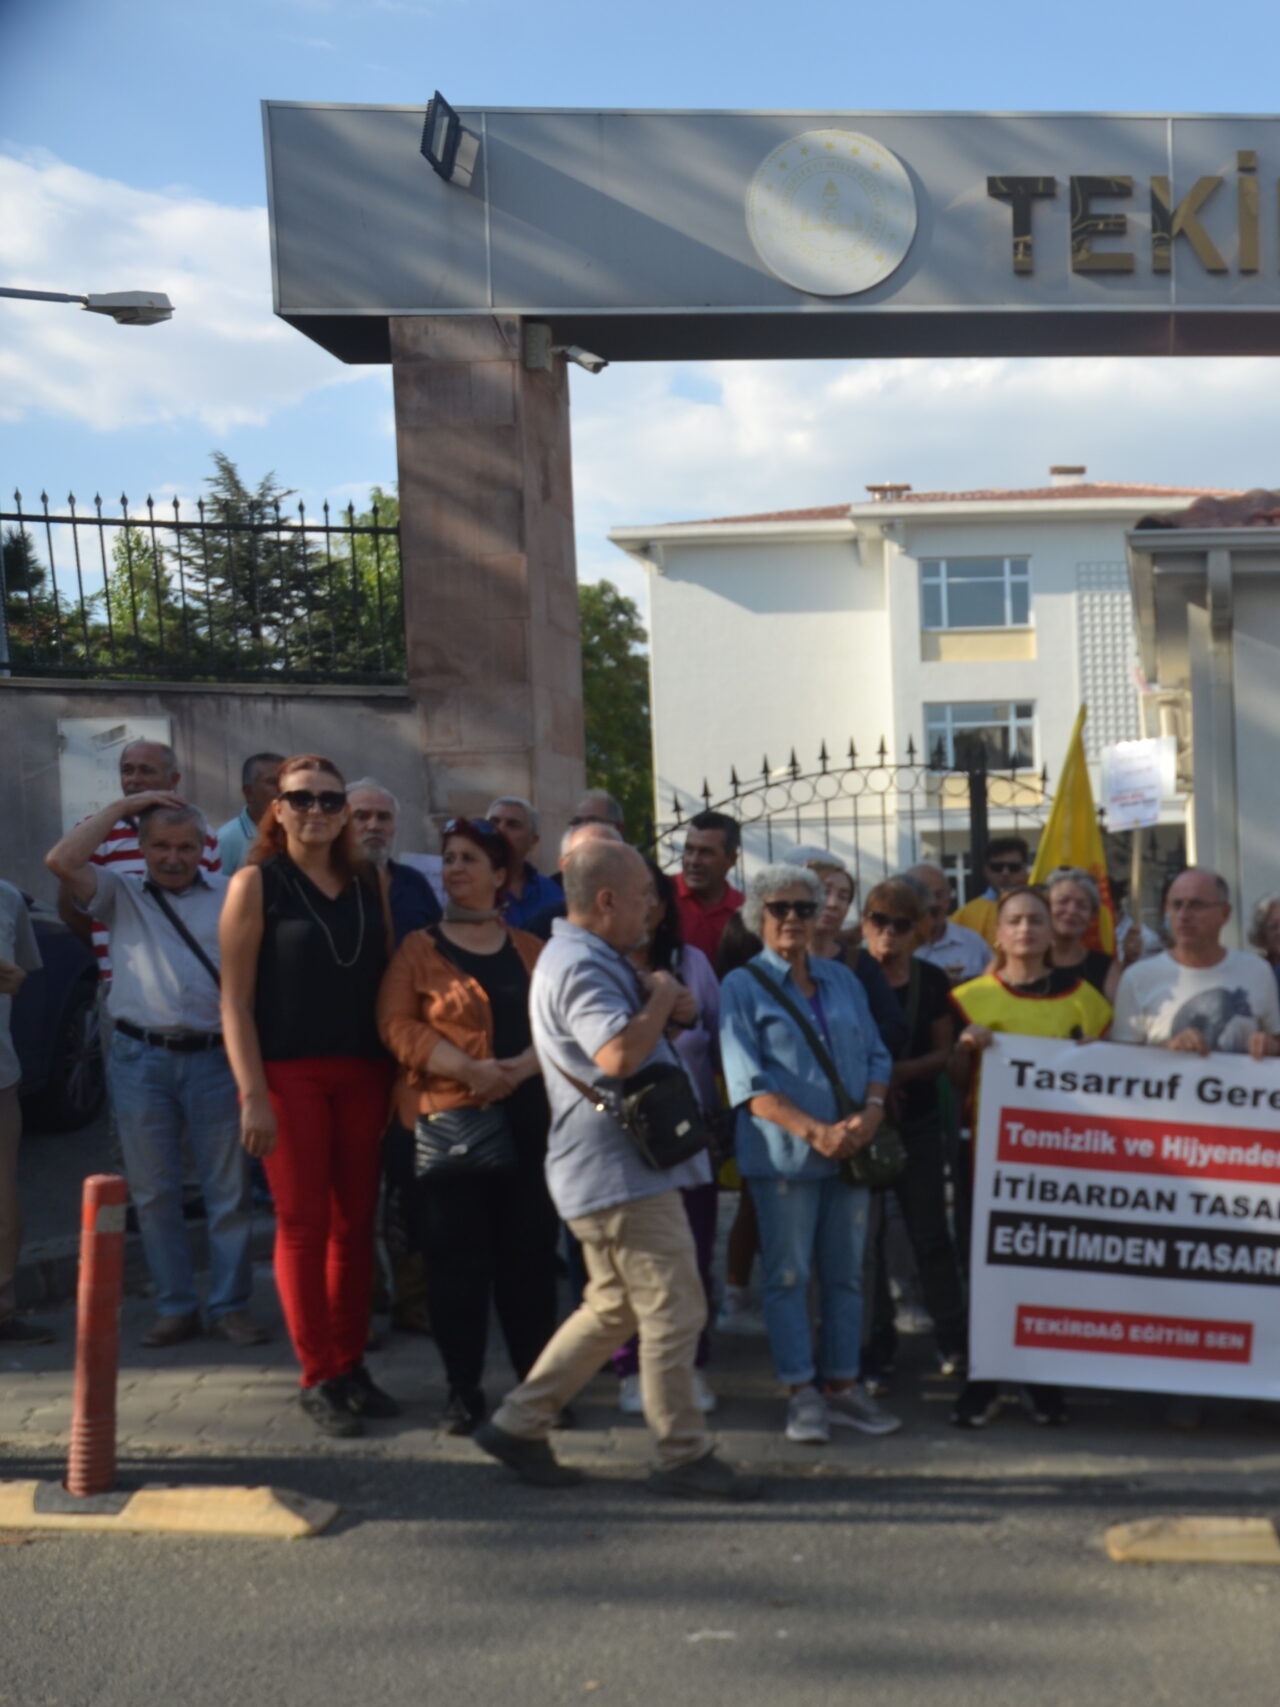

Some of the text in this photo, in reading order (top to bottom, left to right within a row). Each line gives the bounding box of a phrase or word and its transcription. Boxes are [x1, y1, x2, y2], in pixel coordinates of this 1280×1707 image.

[1010, 1059, 1182, 1101] Tasarruf
[1005, 1121, 1117, 1155] Temizlik
[1122, 1138, 1154, 1158] ve
[993, 1170, 1177, 1213] İTİBARDAN
[993, 1222, 1166, 1268] EĞİTİMDEN
[1022, 1315, 1246, 1349] TEKİRDAĞ EĞİTİM SEN
